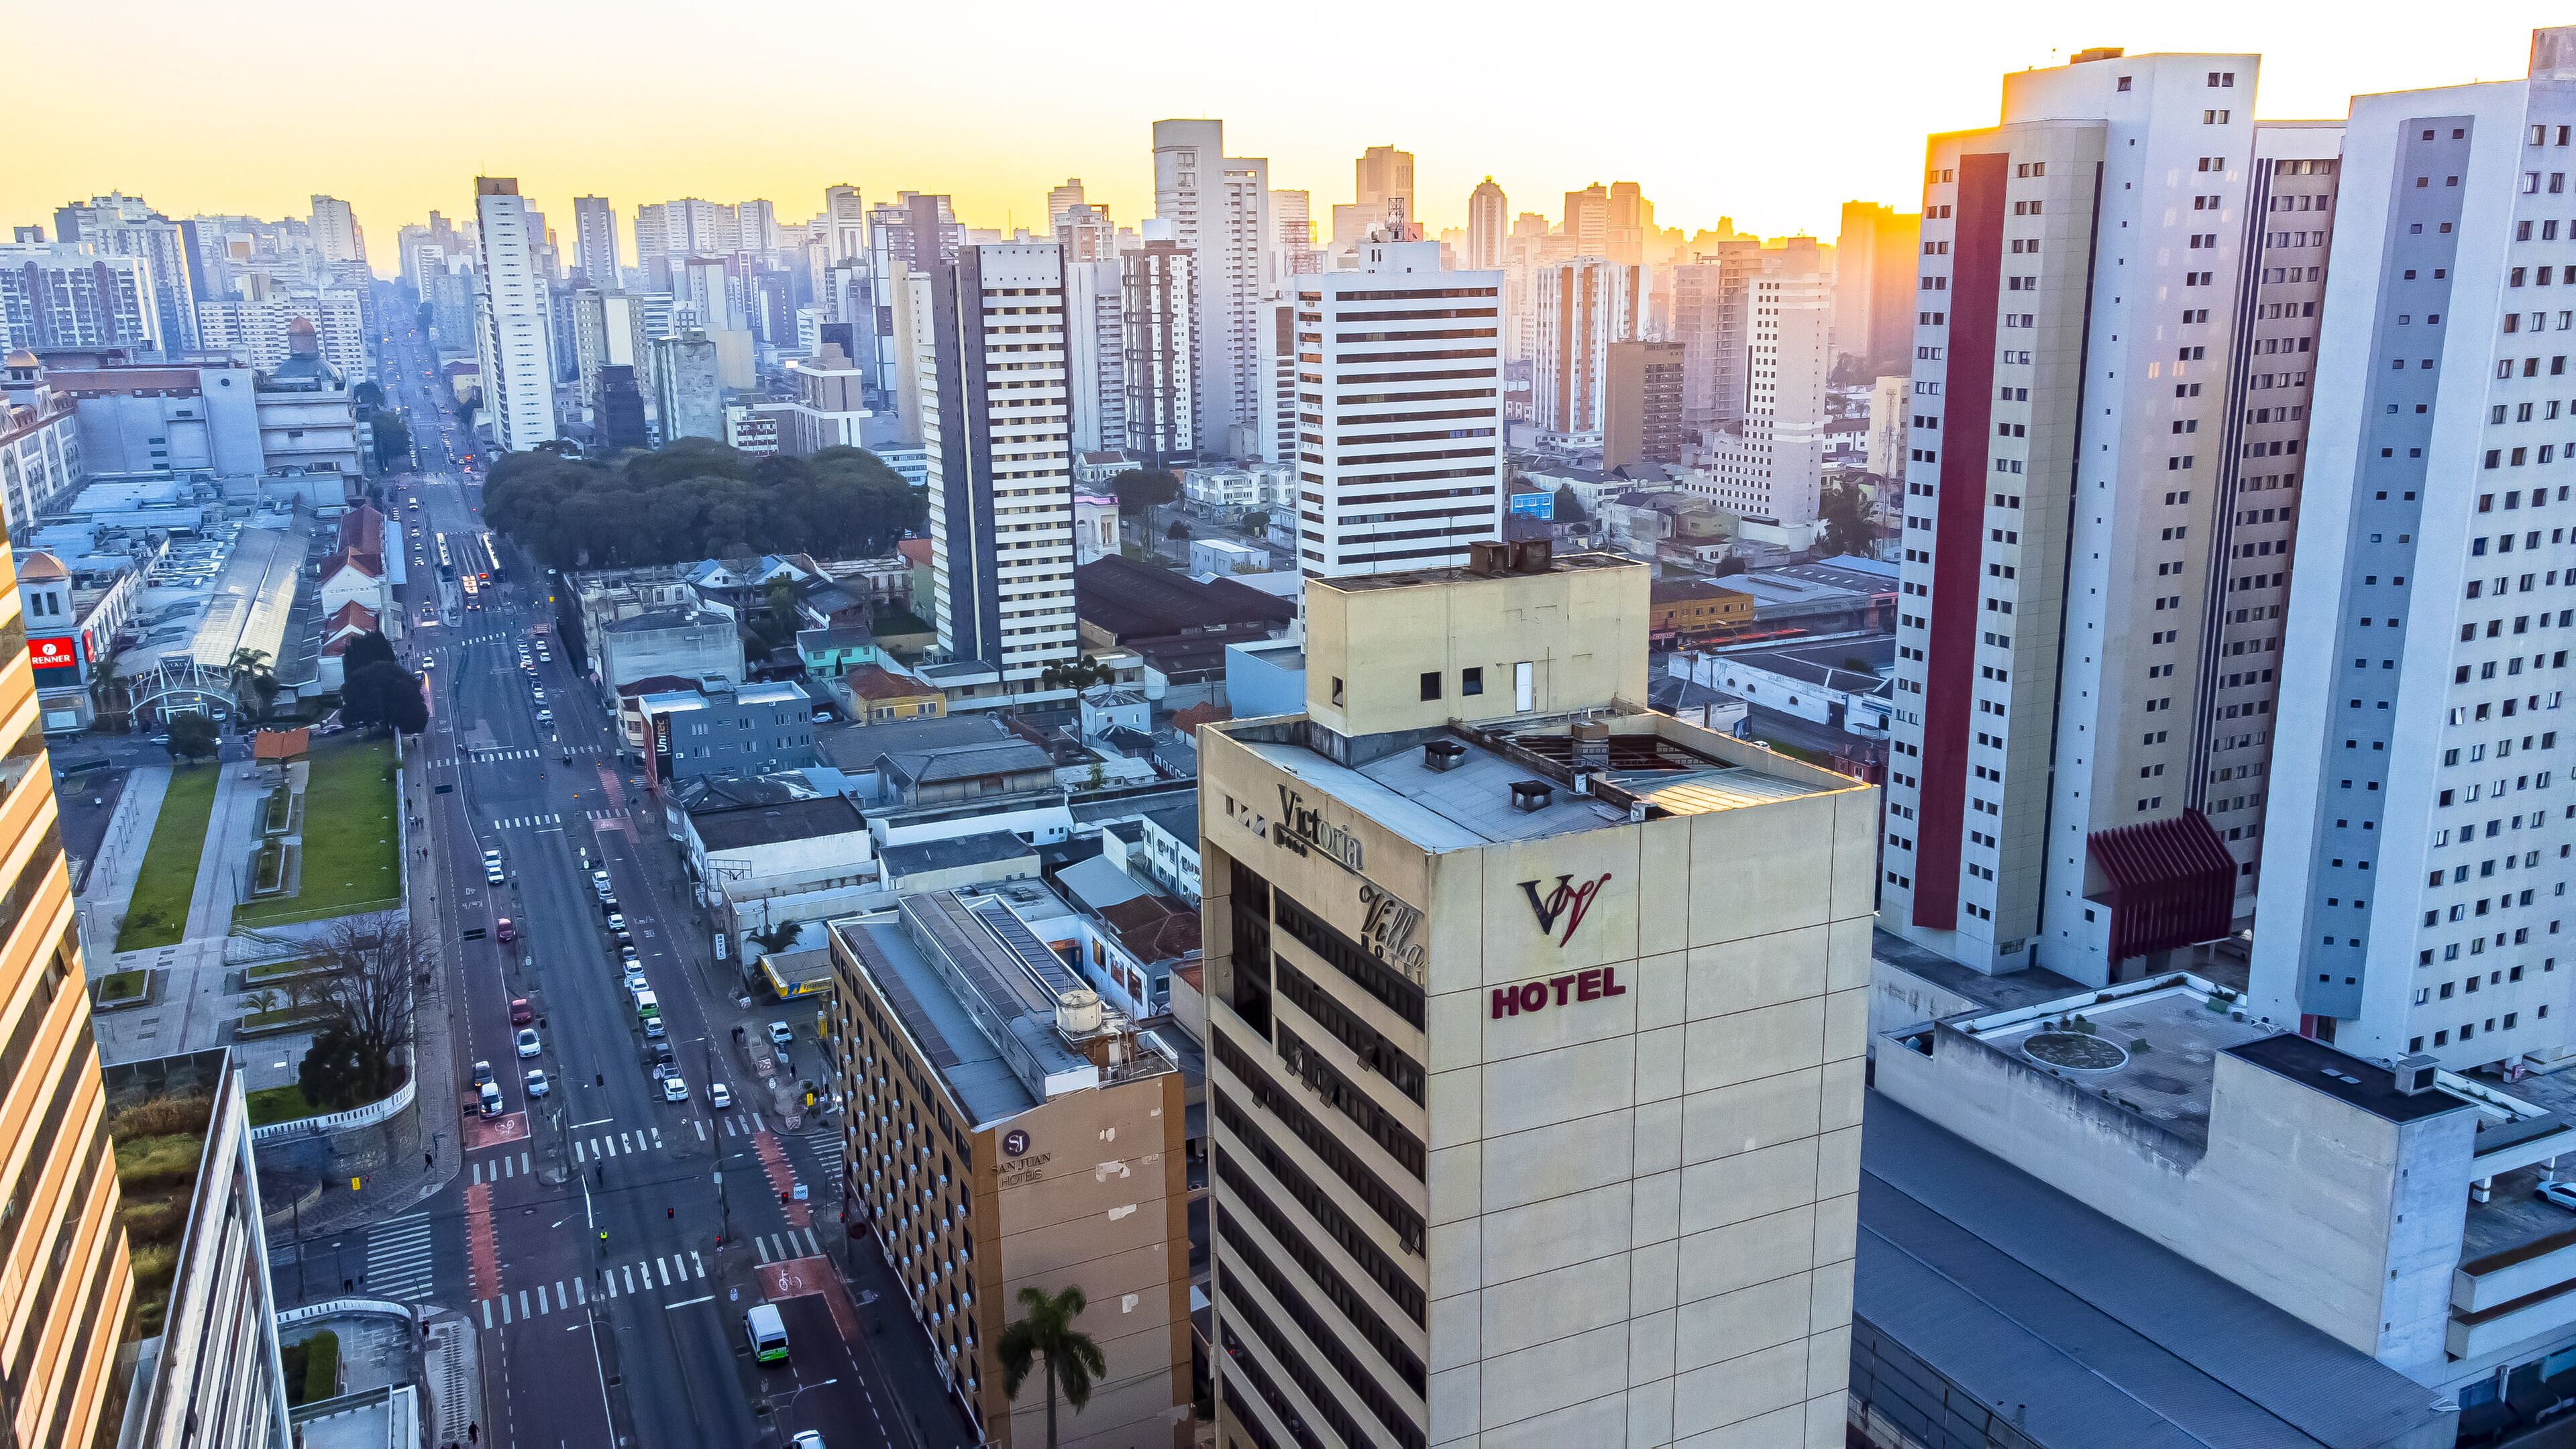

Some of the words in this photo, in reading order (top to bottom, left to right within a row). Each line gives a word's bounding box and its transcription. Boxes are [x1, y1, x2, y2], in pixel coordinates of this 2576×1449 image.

[32, 654, 71, 665] RENNER
[657, 719, 667, 752] Unitec
[1276, 782, 1364, 871] Victoria
[1359, 884, 1425, 968] Villa
[716, 934, 725, 957] HOTEL
[1492, 967, 1626, 1020] HOTEL
[1008, 1134, 1024, 1152] SJ
[990, 1160, 1016, 1176] SAN
[1018, 1152, 1051, 1171] JUAN
